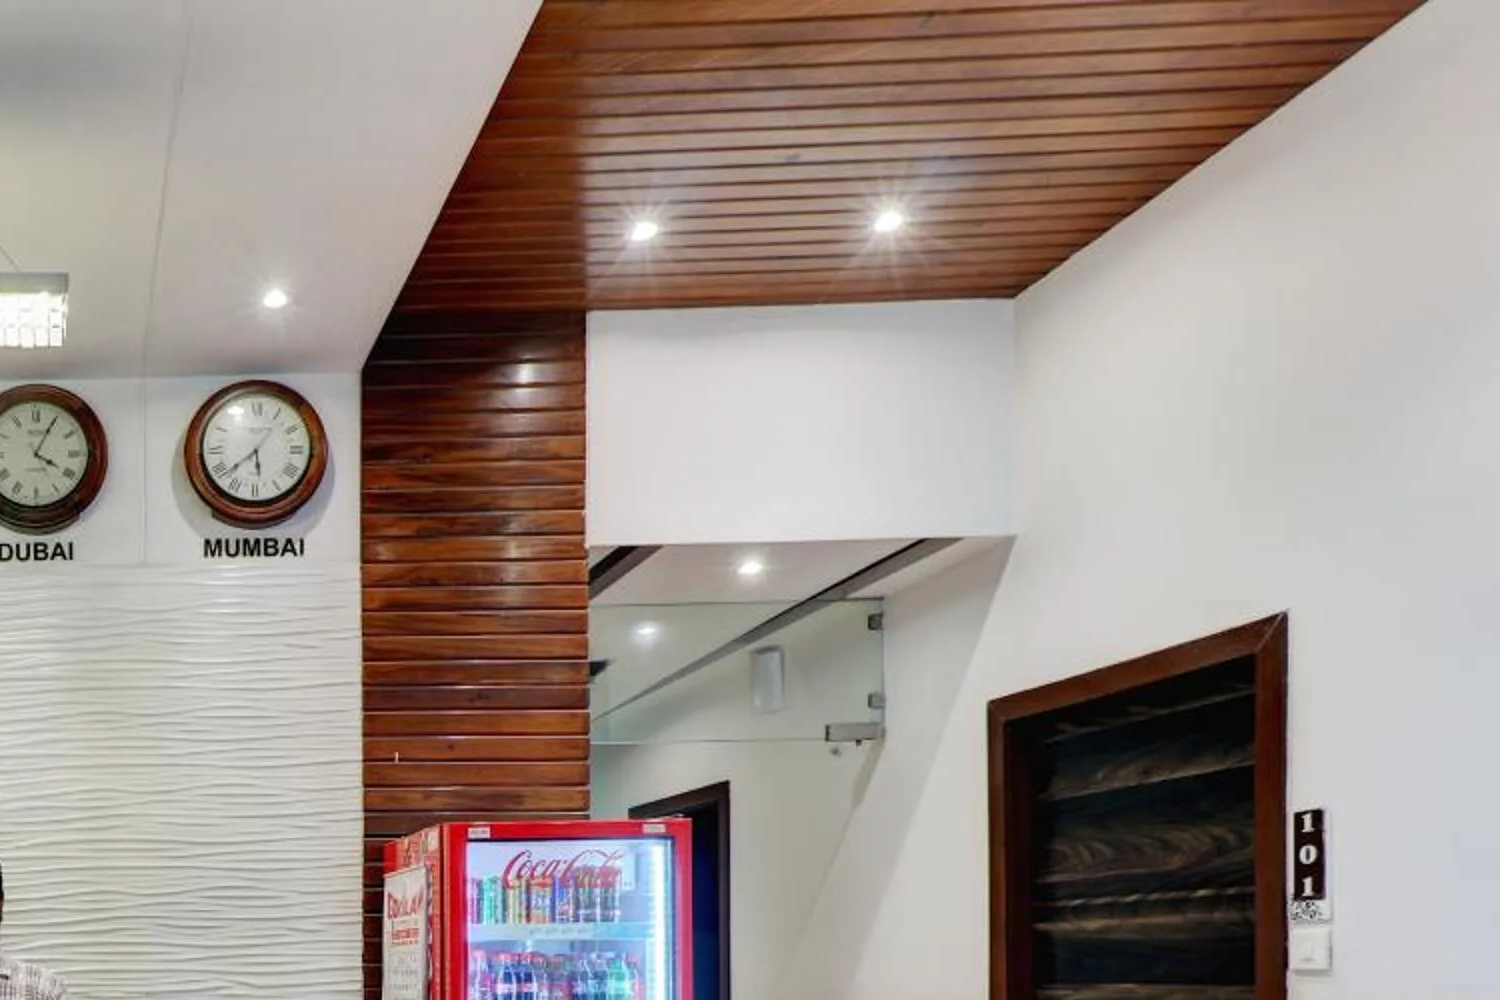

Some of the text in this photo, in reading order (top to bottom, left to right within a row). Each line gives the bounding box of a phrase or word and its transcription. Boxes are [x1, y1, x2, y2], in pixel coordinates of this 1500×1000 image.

[203, 537, 305, 558] MUMBAI
[503, 849, 624, 890] Coca-C
[1298, 812, 1318, 897] 101
